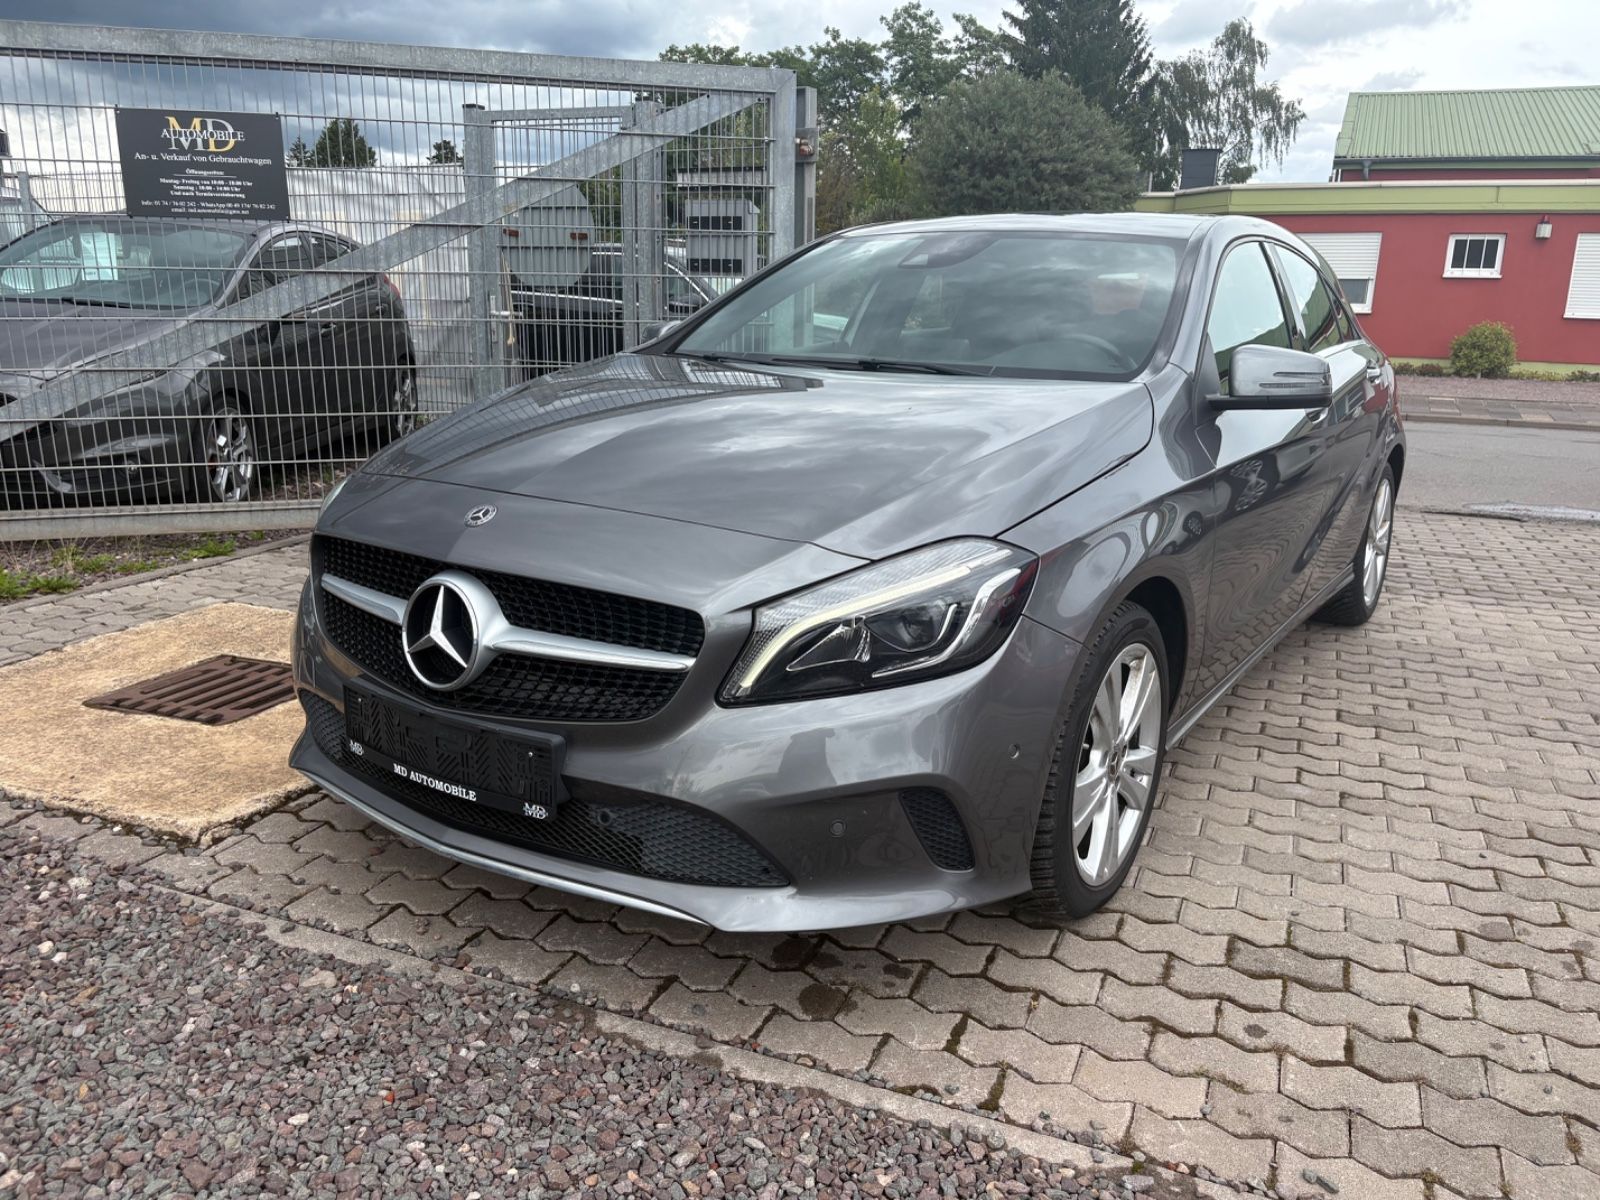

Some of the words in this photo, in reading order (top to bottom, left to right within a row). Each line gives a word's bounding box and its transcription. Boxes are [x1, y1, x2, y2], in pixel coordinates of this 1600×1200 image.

[161, 128, 245, 141] AUTOMOBILE
[165, 115, 236, 152] MD
[134, 152, 150, 160] An-
[160, 153, 191, 162] Verkauf
[209, 154, 272, 166] Gebrauchtwagen
[393, 762, 408, 776] MD
